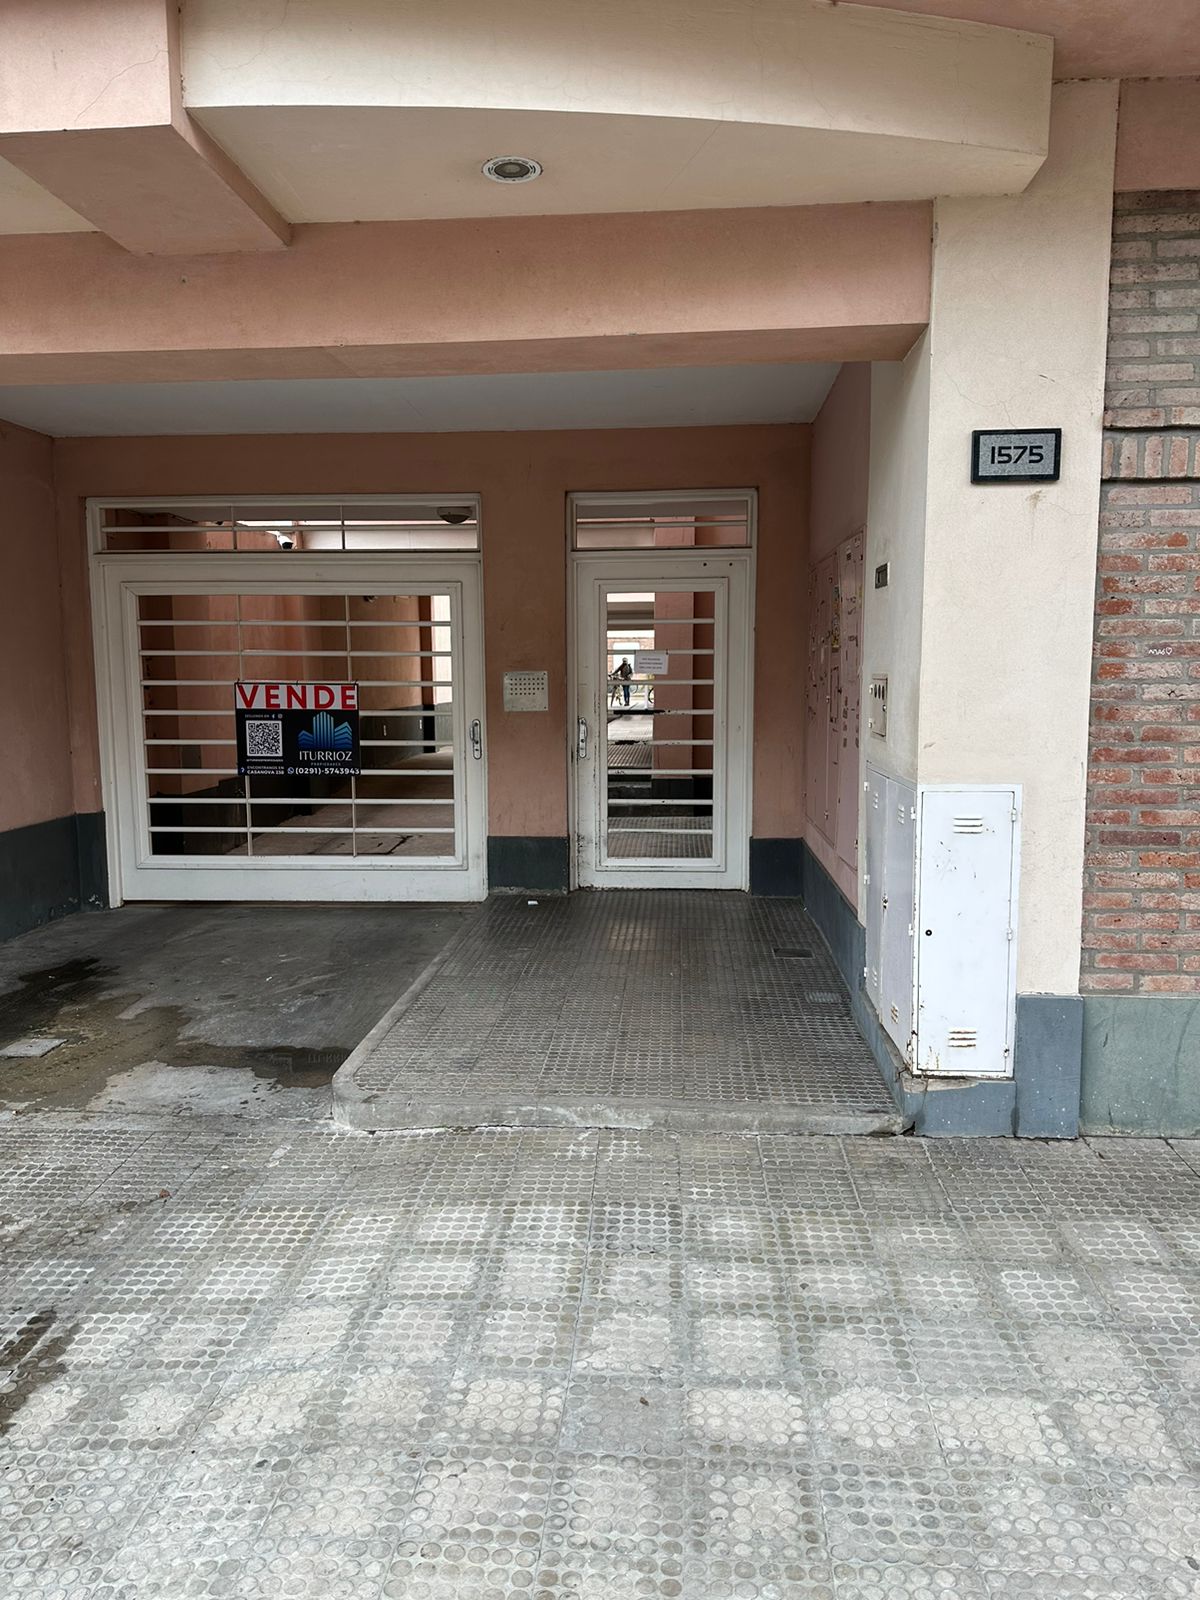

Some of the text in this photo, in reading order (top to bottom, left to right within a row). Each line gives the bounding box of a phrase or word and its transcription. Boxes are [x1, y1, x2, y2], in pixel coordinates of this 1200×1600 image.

[990, 445, 1044, 464] 1575
[237, 684, 357, 709] VENDE
[299, 751, 353, 761] ITURRIOZ
[295, 767, 360, 775] (0291)-5743943
